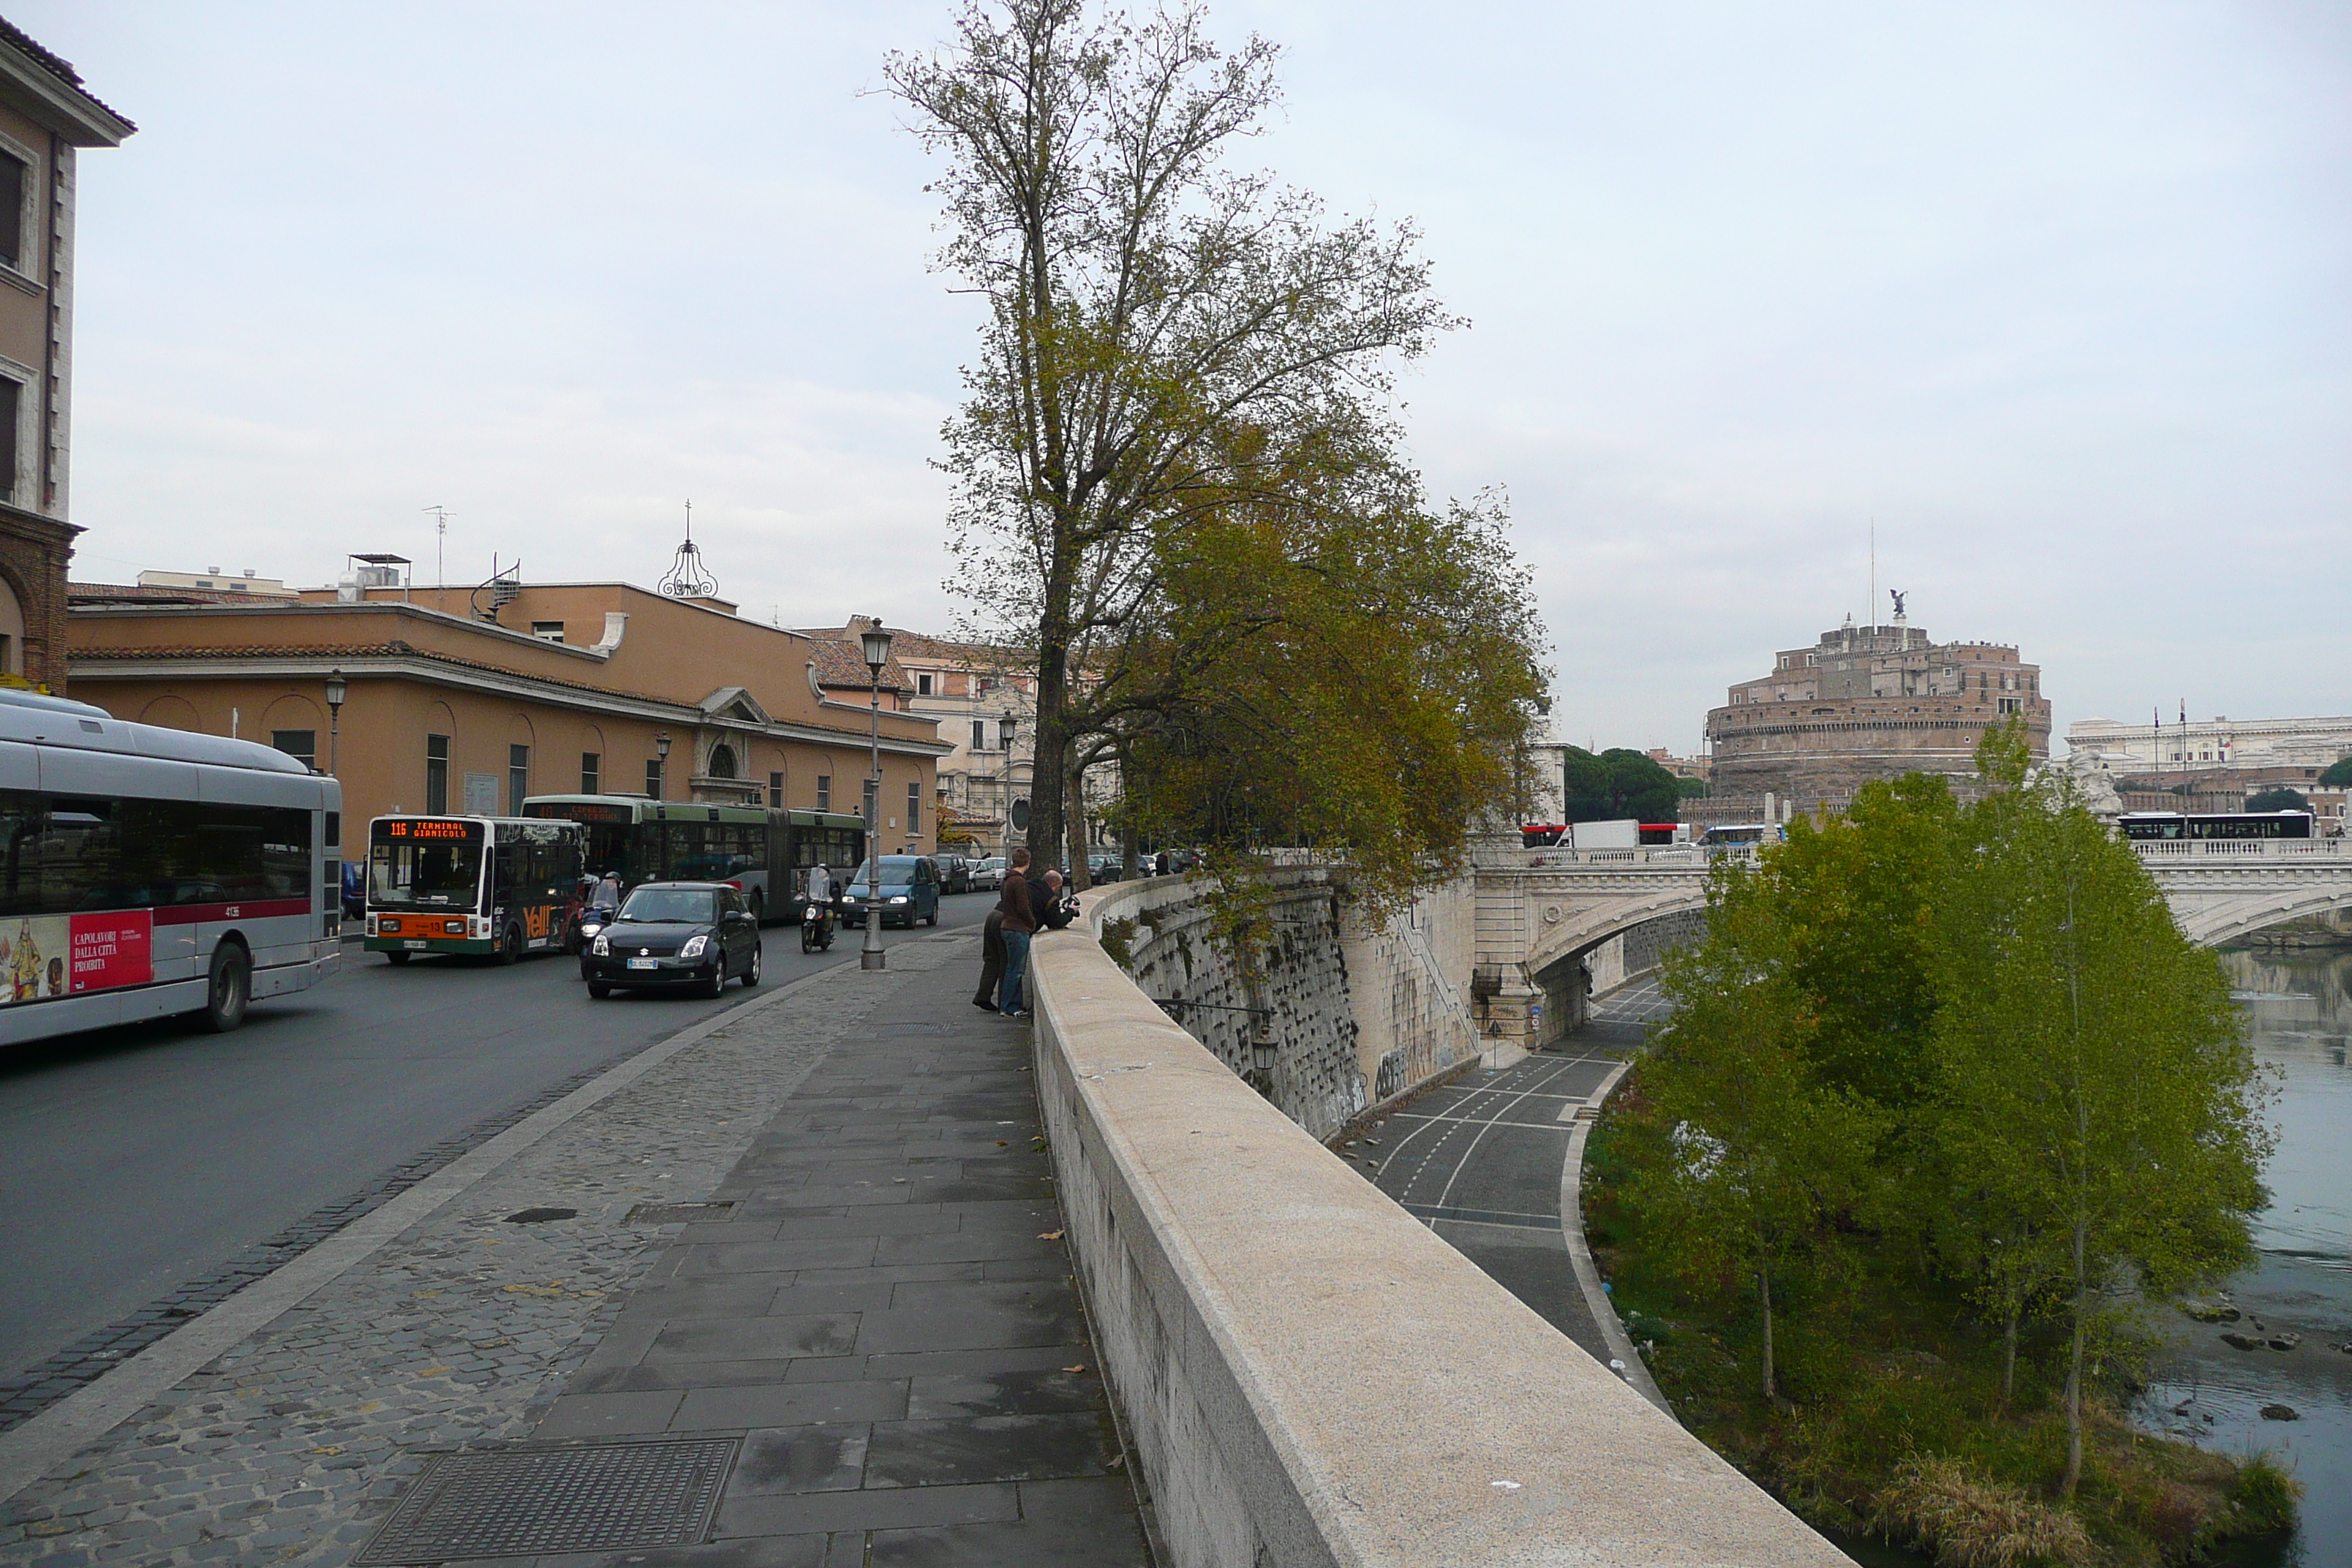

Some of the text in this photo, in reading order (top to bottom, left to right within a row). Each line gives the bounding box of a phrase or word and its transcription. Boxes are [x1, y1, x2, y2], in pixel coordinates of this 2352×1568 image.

[539, 805, 554, 818] 40
[391, 823, 407, 835] 116
[430, 923, 440, 931] 13
[75, 931, 116, 945] CAPOLAVORI
[75, 942, 117, 959] DALLA CITTÀ
[75, 959, 105, 973] PROIBITA
